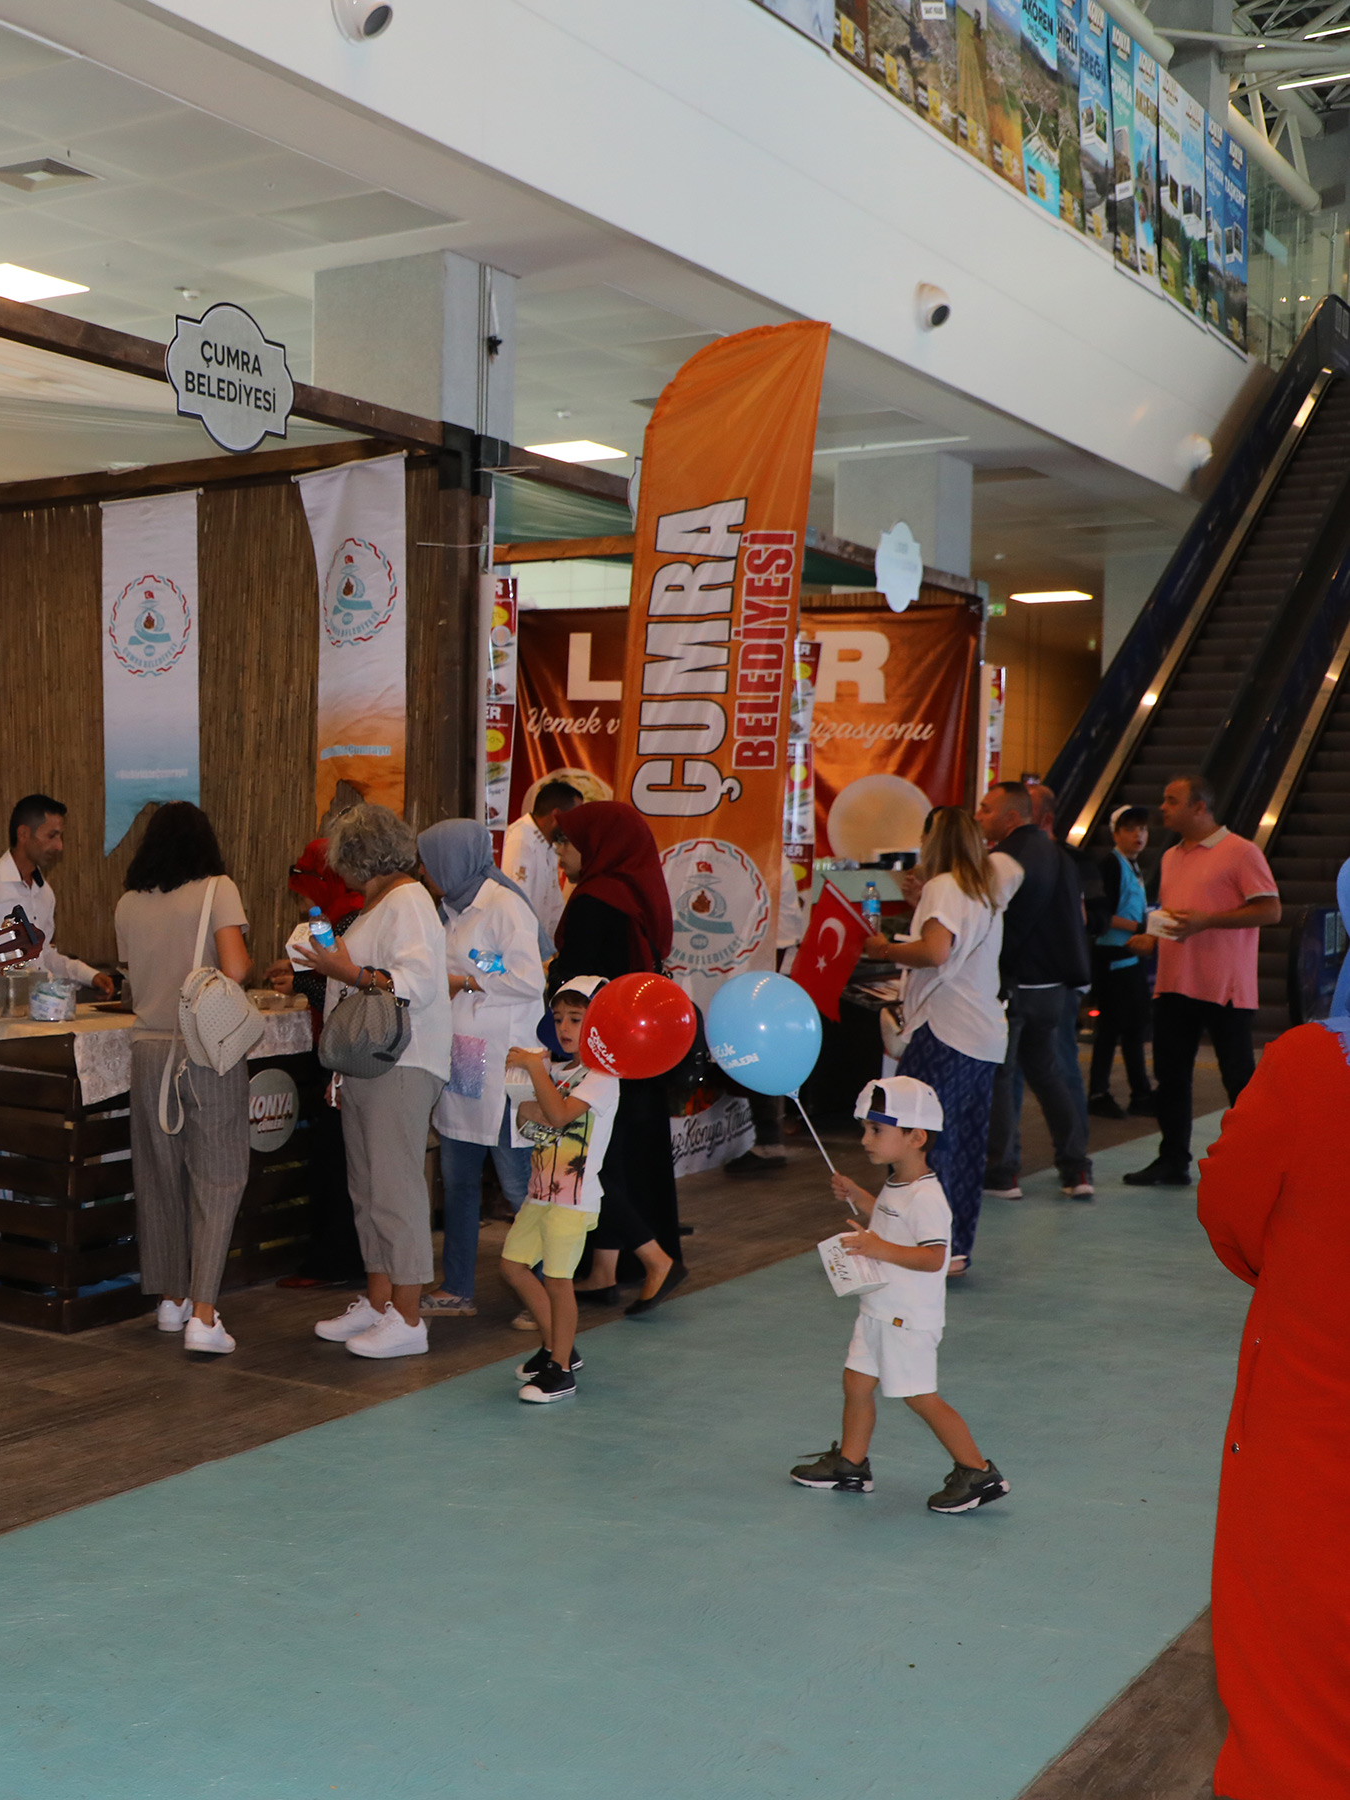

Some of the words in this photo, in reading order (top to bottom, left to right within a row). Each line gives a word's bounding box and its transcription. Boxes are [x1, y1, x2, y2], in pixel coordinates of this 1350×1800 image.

[200, 340, 262, 377] ÇUMRA
[185, 369, 276, 414] BELEDİYESİ
[630, 497, 749, 818] ÇUMRA
[734, 529, 797, 770] BELEDİYESİ
[527, 706, 602, 740] Yemek
